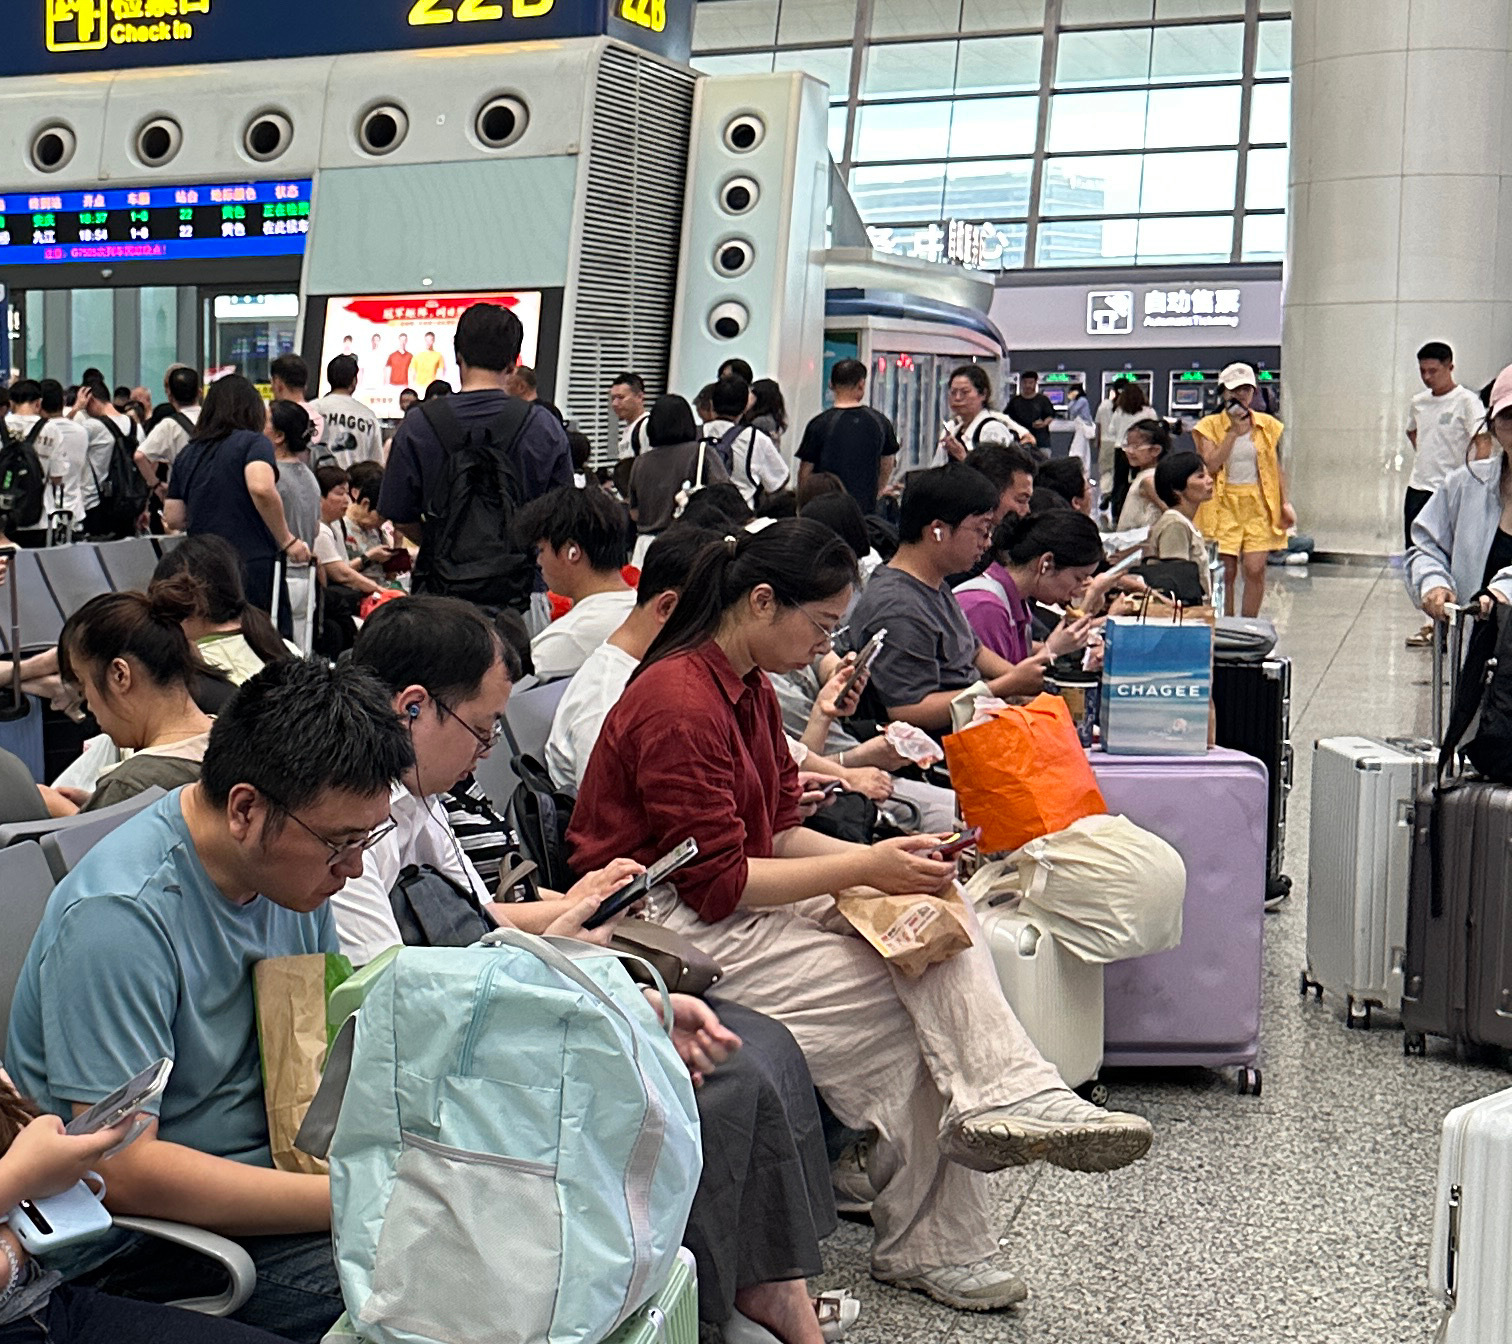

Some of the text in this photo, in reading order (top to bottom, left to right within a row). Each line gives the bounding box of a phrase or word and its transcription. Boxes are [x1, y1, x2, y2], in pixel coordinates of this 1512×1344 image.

[110, 21, 171, 45] Check
[322, 412, 376, 436] HAGGY
[1117, 683, 1201, 698] CHAGEE
